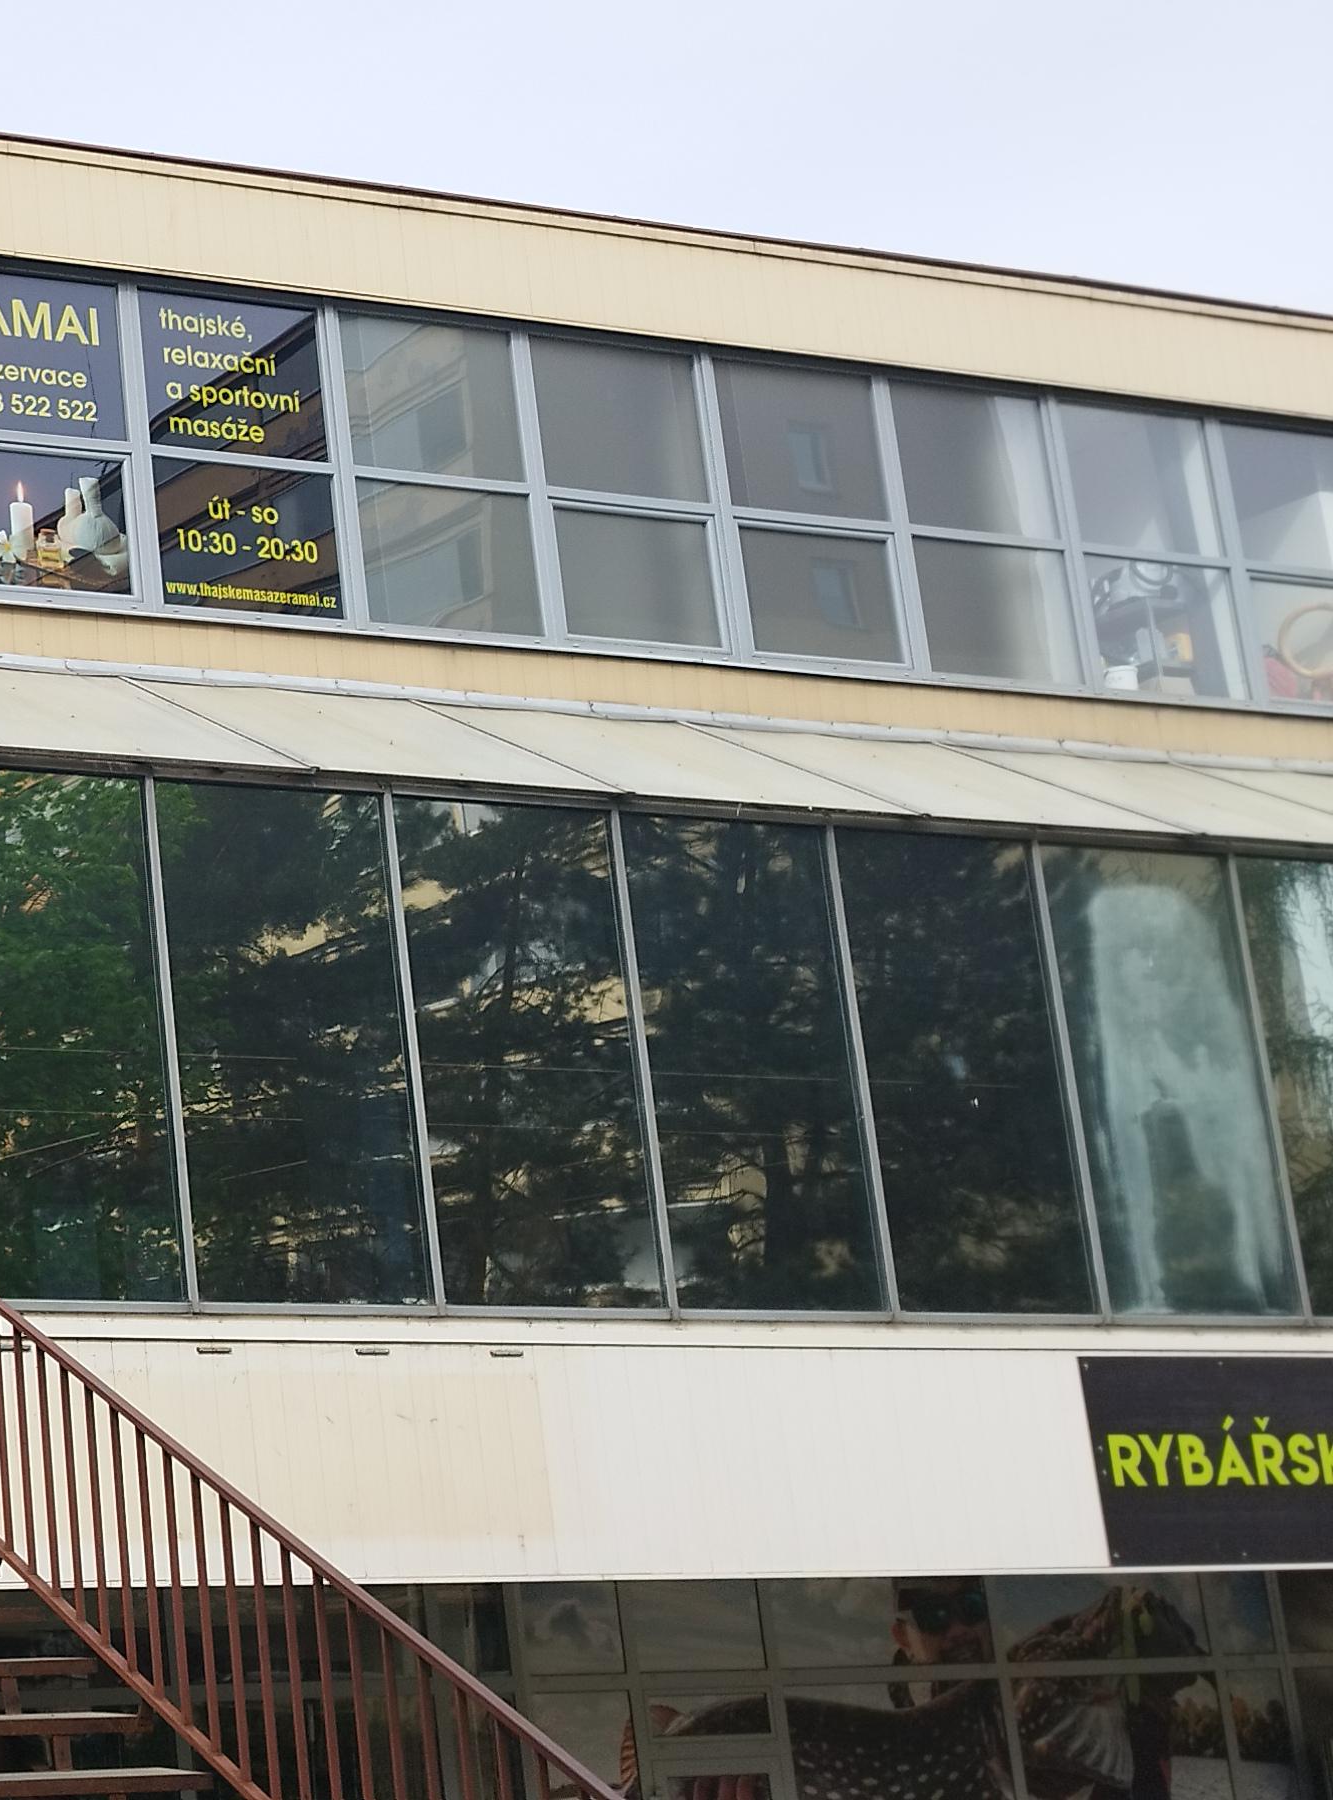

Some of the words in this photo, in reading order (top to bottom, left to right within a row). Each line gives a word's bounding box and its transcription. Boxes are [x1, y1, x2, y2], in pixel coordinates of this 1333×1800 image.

[159, 307, 253, 342] thajské,
[163, 345, 276, 376] relaxační
[11, 394, 52, 417] 522
[57, 399, 99, 422] 522
[166, 381, 183, 400] a
[189, 384, 300, 413] sportovní
[169, 416, 265, 443] masáže
[208, 495, 231, 520] út
[251, 506, 279, 525] so
[177, 528, 237, 556] 10:30
[256, 536, 318, 564] 20:30
[165, 581, 337, 609] www.thajskemasazeramai.cz
